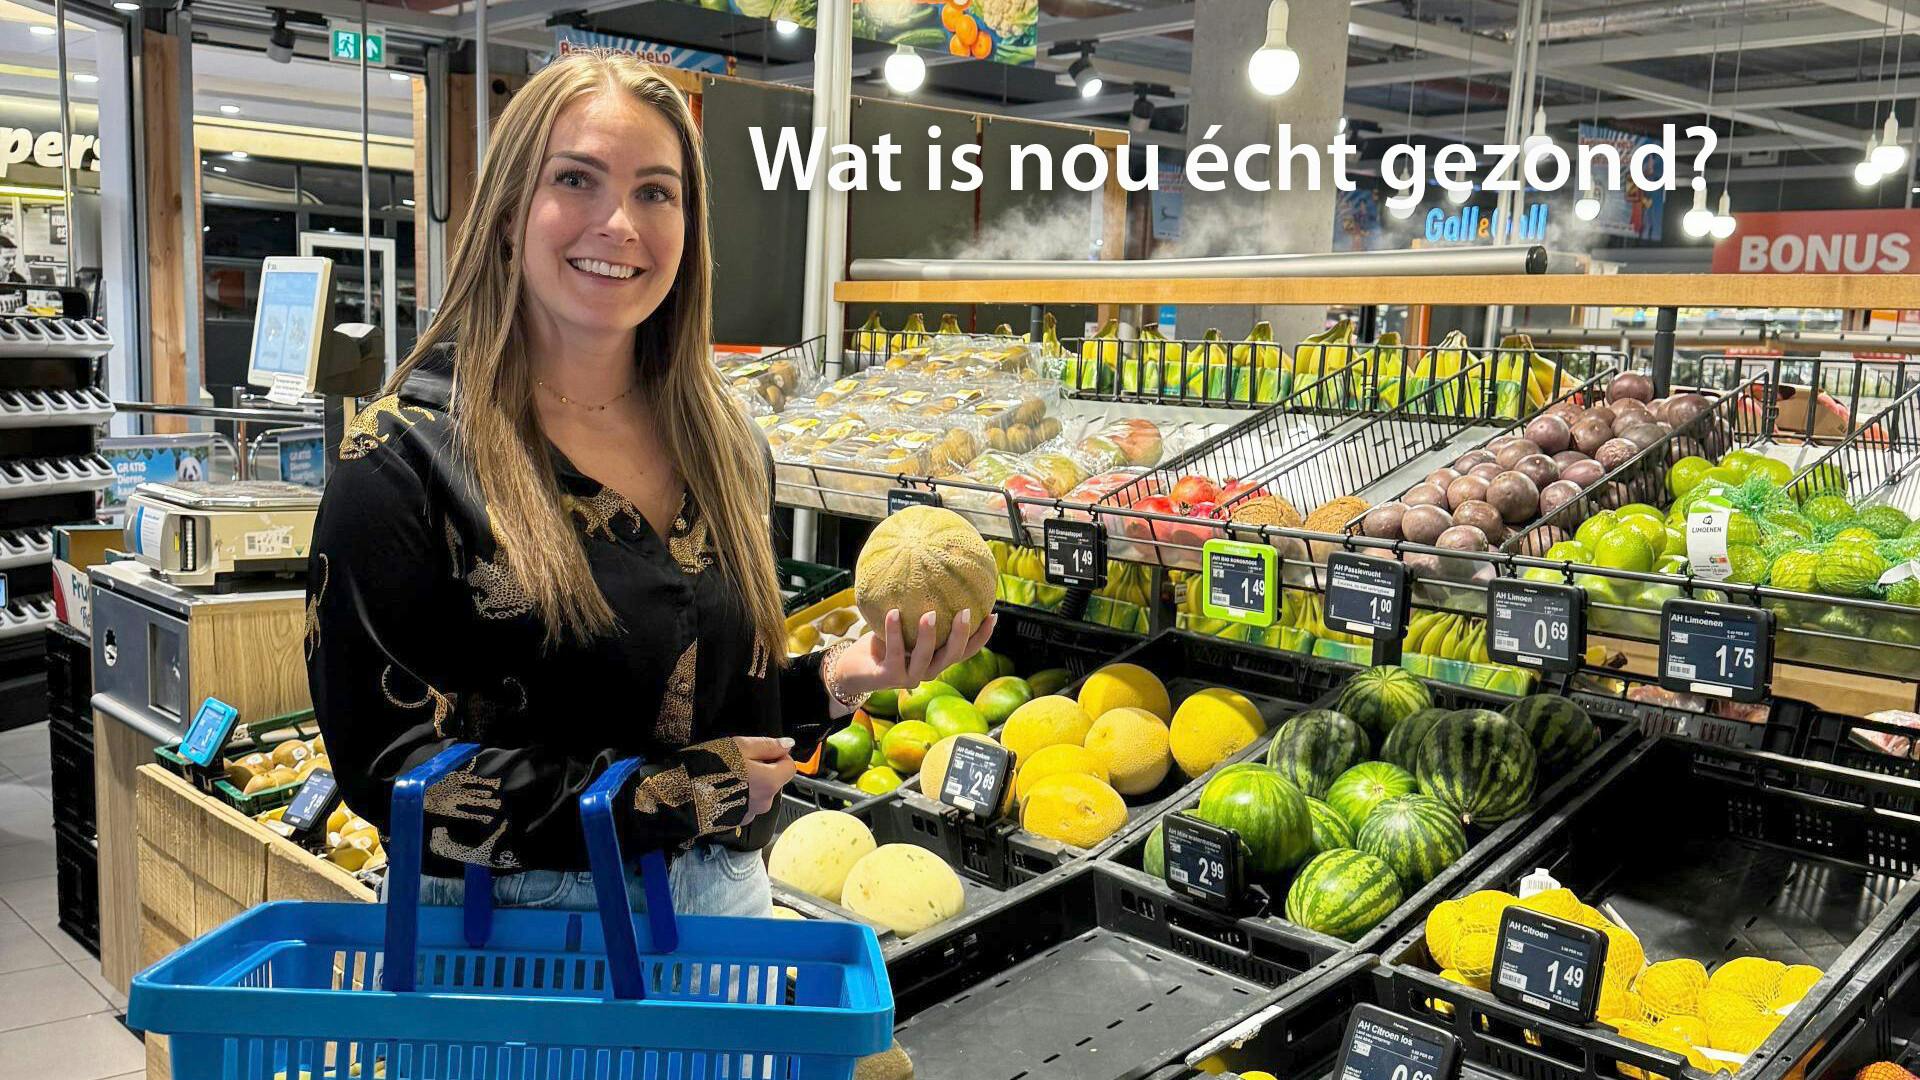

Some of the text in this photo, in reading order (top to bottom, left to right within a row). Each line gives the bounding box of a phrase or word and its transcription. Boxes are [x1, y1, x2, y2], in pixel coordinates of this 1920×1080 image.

[1425, 205, 1479, 242] Gall
[1739, 232, 1912, 273] BONUS
[117, 462, 147, 473] GRATIS
[1072, 549, 1093, 573] 1.49
[1344, 565, 1382, 578] Passievrucht
[1241, 577, 1265, 604] 1.49
[1507, 592, 1533, 603] Limoen
[1369, 596, 1392, 621] 1.00
[1671, 614, 1724, 628] AH Limoenen
[1534, 619, 1568, 650] 0.69
[1715, 645, 1754, 678] 1.75
[969, 770, 995, 797] 2.69
[1198, 857, 1224, 886] 2.99
[1509, 921, 1549, 940] AH Citroen
[1547, 960, 1584, 995] 1.49
[1358, 1020, 1413, 1046] AH Citroen los
